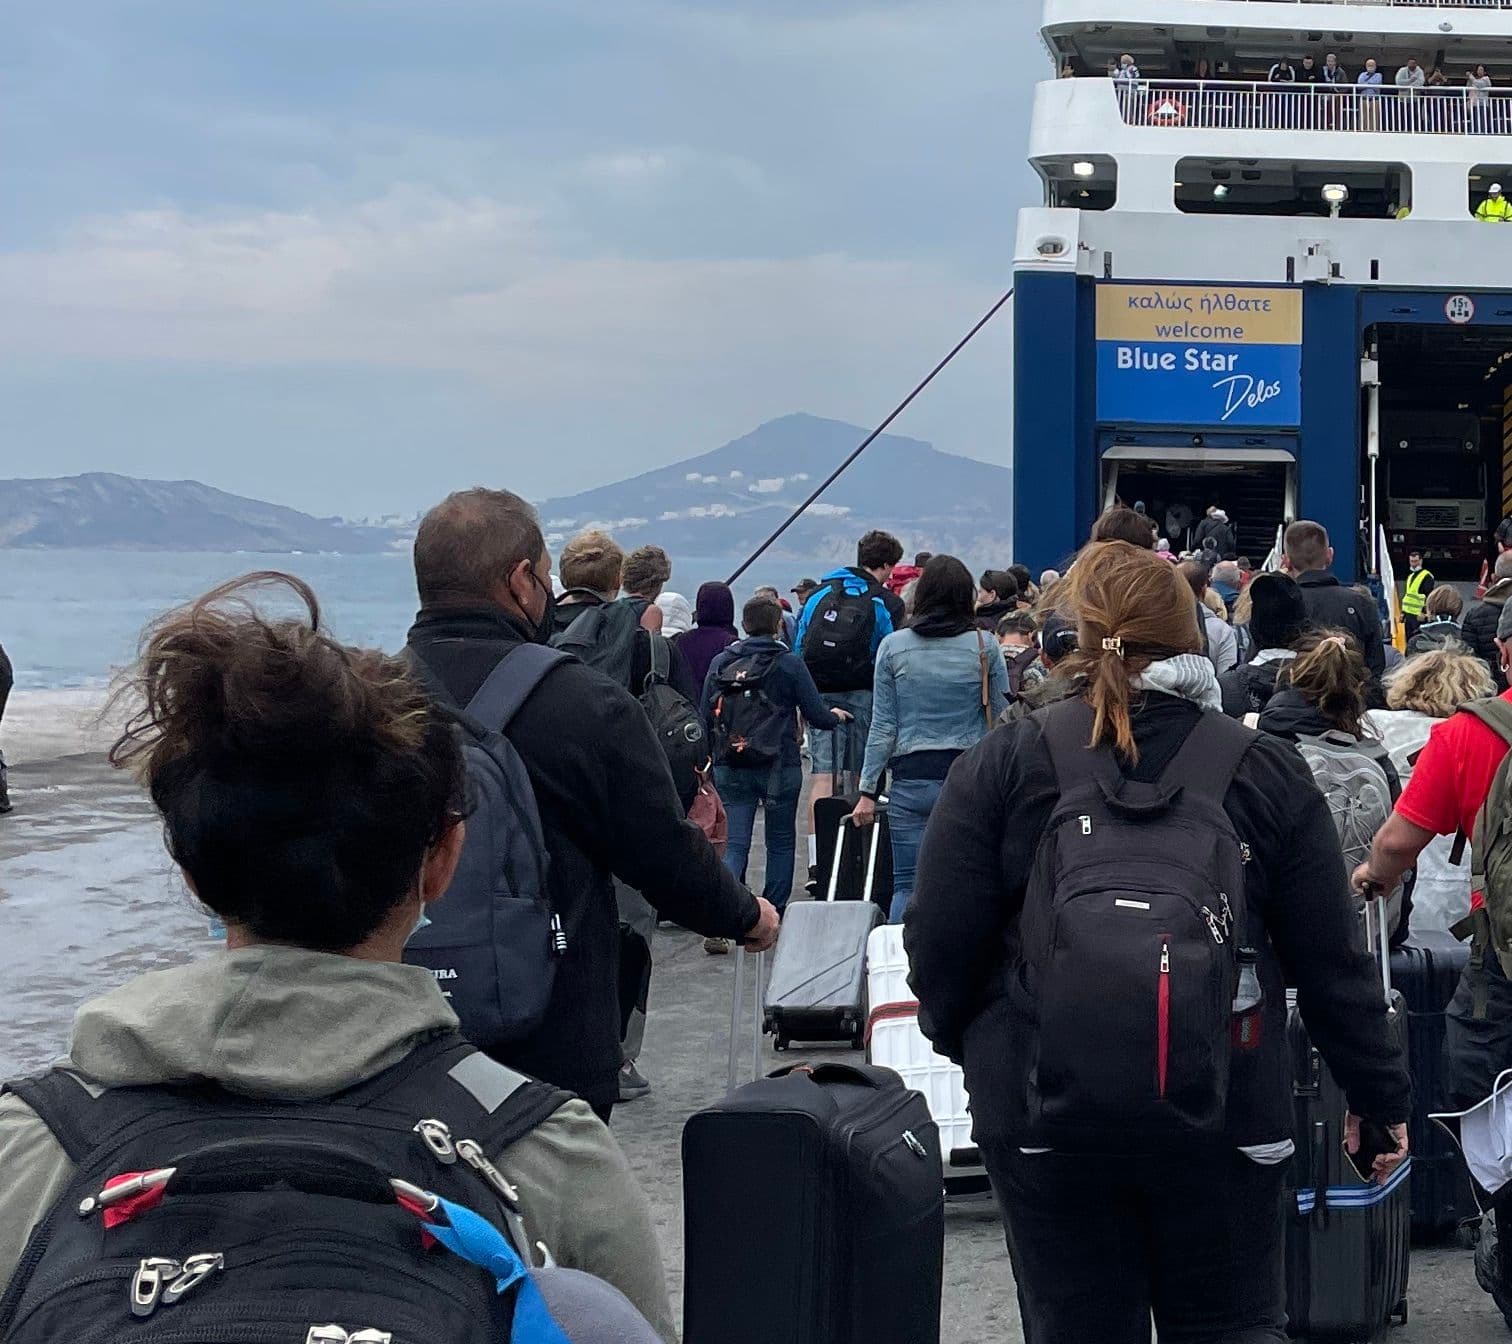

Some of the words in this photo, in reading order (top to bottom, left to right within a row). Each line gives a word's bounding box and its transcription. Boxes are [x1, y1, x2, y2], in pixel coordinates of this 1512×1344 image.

[1128, 292, 1193, 312] καλώς
[1200, 292, 1272, 315] ήλθατε
[1155, 321, 1244, 339] welcome
[1117, 346, 1177, 370] Blue
[1184, 348, 1239, 372] Star
[1212, 374, 1281, 421] Delos
